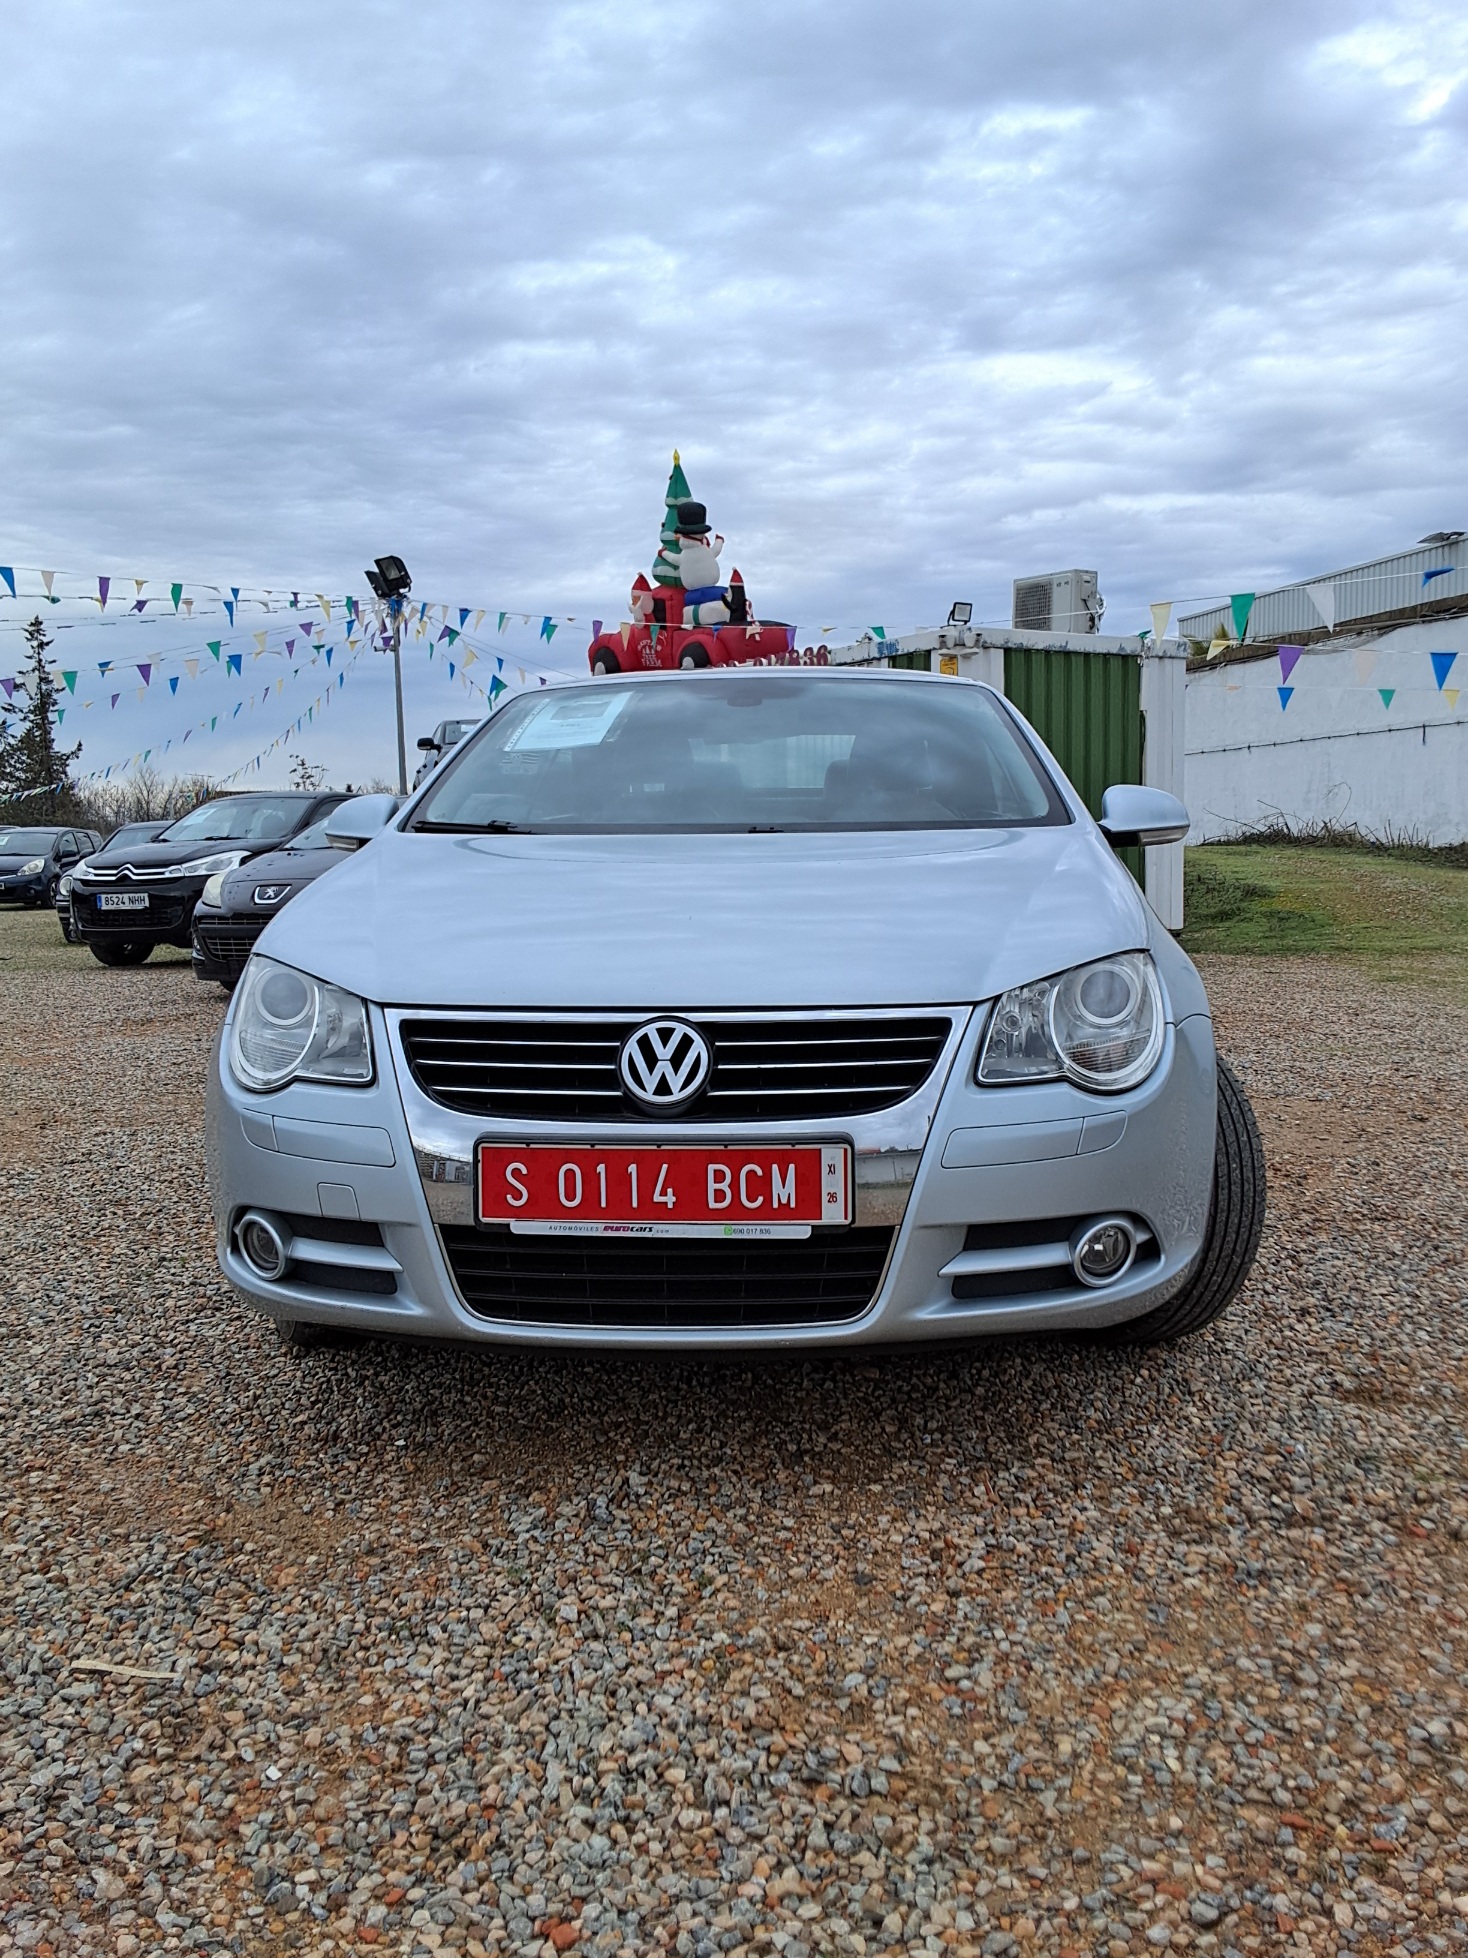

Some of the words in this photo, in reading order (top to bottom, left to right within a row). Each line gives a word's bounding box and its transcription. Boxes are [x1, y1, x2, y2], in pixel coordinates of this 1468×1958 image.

[104, 896, 126, 906] 8524
[128, 895, 146, 905] NHH
[827, 1163, 836, 1175] XI
[505, 1162, 529, 1207] S
[558, 1162, 678, 1209] 0114
[707, 1163, 796, 1209] BCM
[827, 1192, 838, 1203] 26
[732, 1227, 745, 1235] 690
